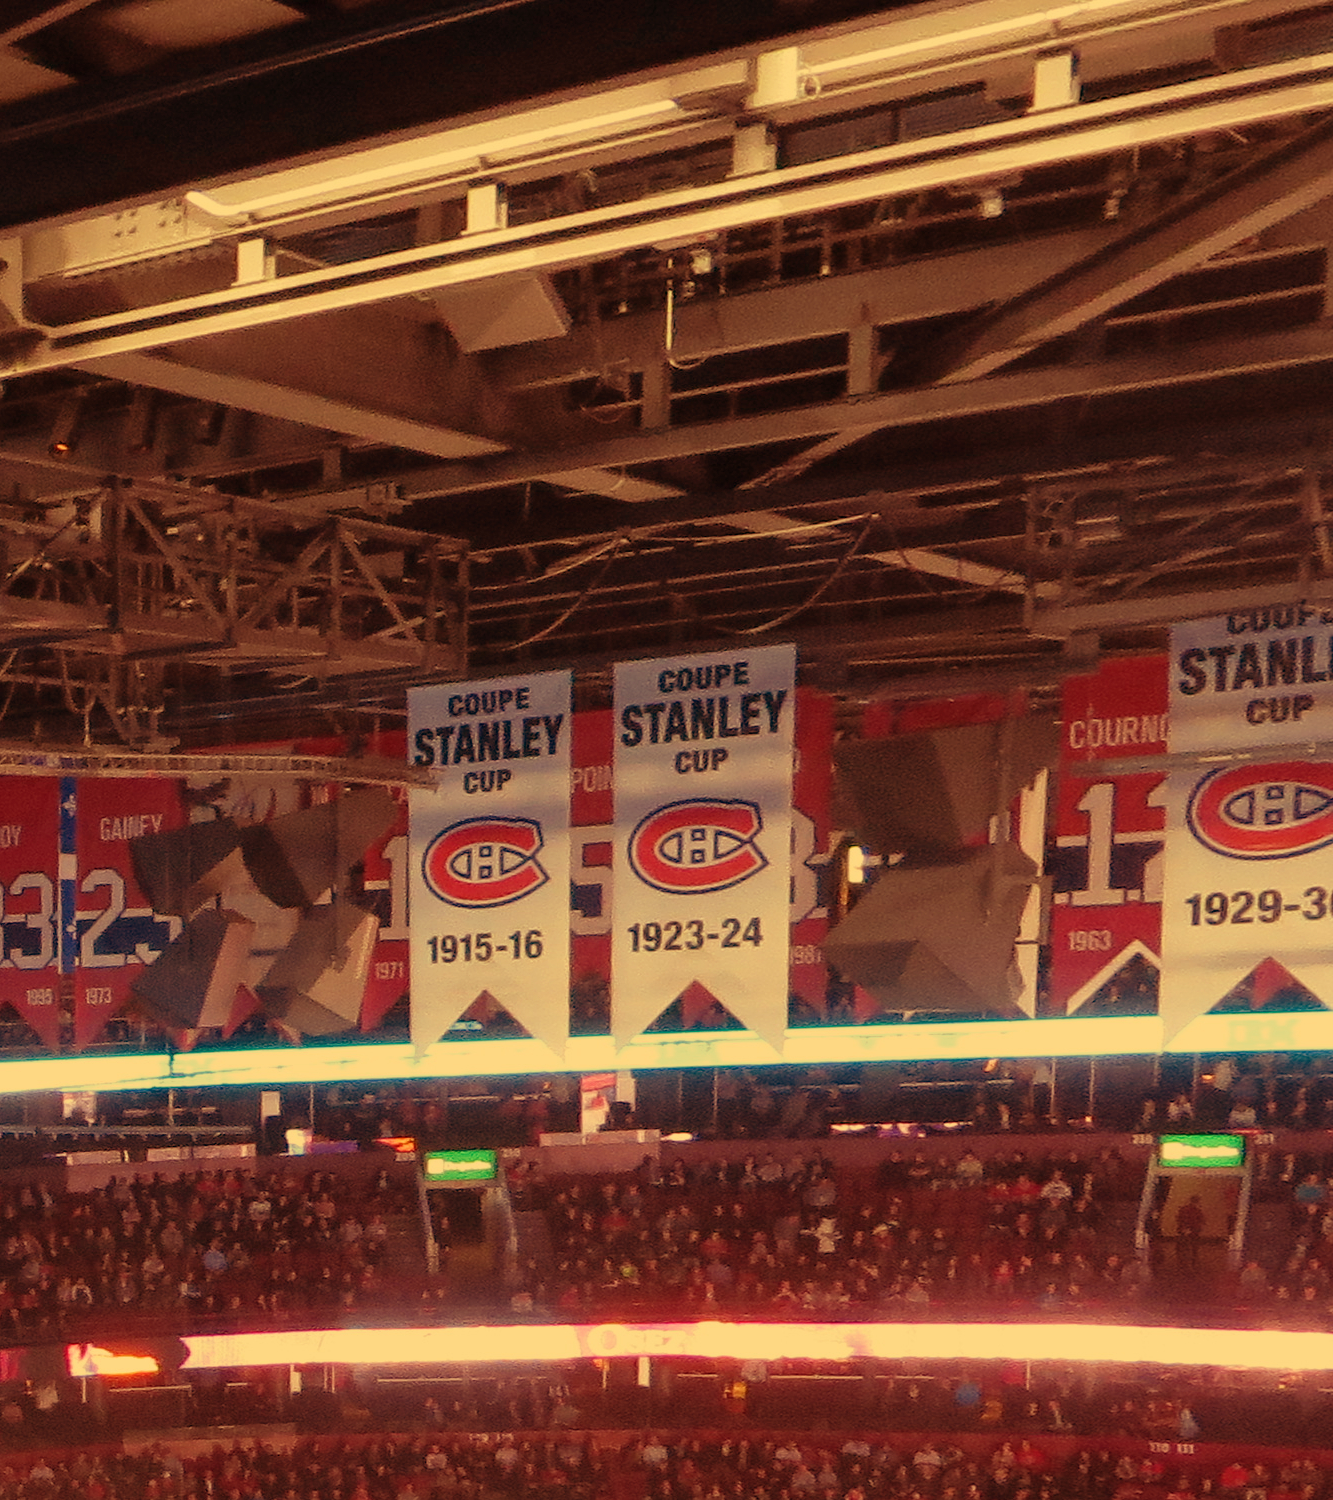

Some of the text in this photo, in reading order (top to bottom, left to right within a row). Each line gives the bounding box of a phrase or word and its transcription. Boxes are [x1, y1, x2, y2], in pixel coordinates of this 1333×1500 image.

[1227, 604, 1333, 634] COUP
[657, 660, 750, 694] COUPE
[447, 686, 531, 718] COUPE
[620, 689, 788, 748] STANLEY
[1246, 694, 1315, 725] CUP
[414, 714, 564, 767] STANLEY
[674, 748, 730, 775] CUP
[463, 769, 513, 795] CUP
[1184, 885, 1333, 927] 1929-3
[426, 929, 545, 964] 1915-16
[627, 916, 764, 953] 1923-24
[1068, 919, 1113, 953] 1963
[374, 960, 404, 980] 1971
[84, 986, 113, 1006] 1973
